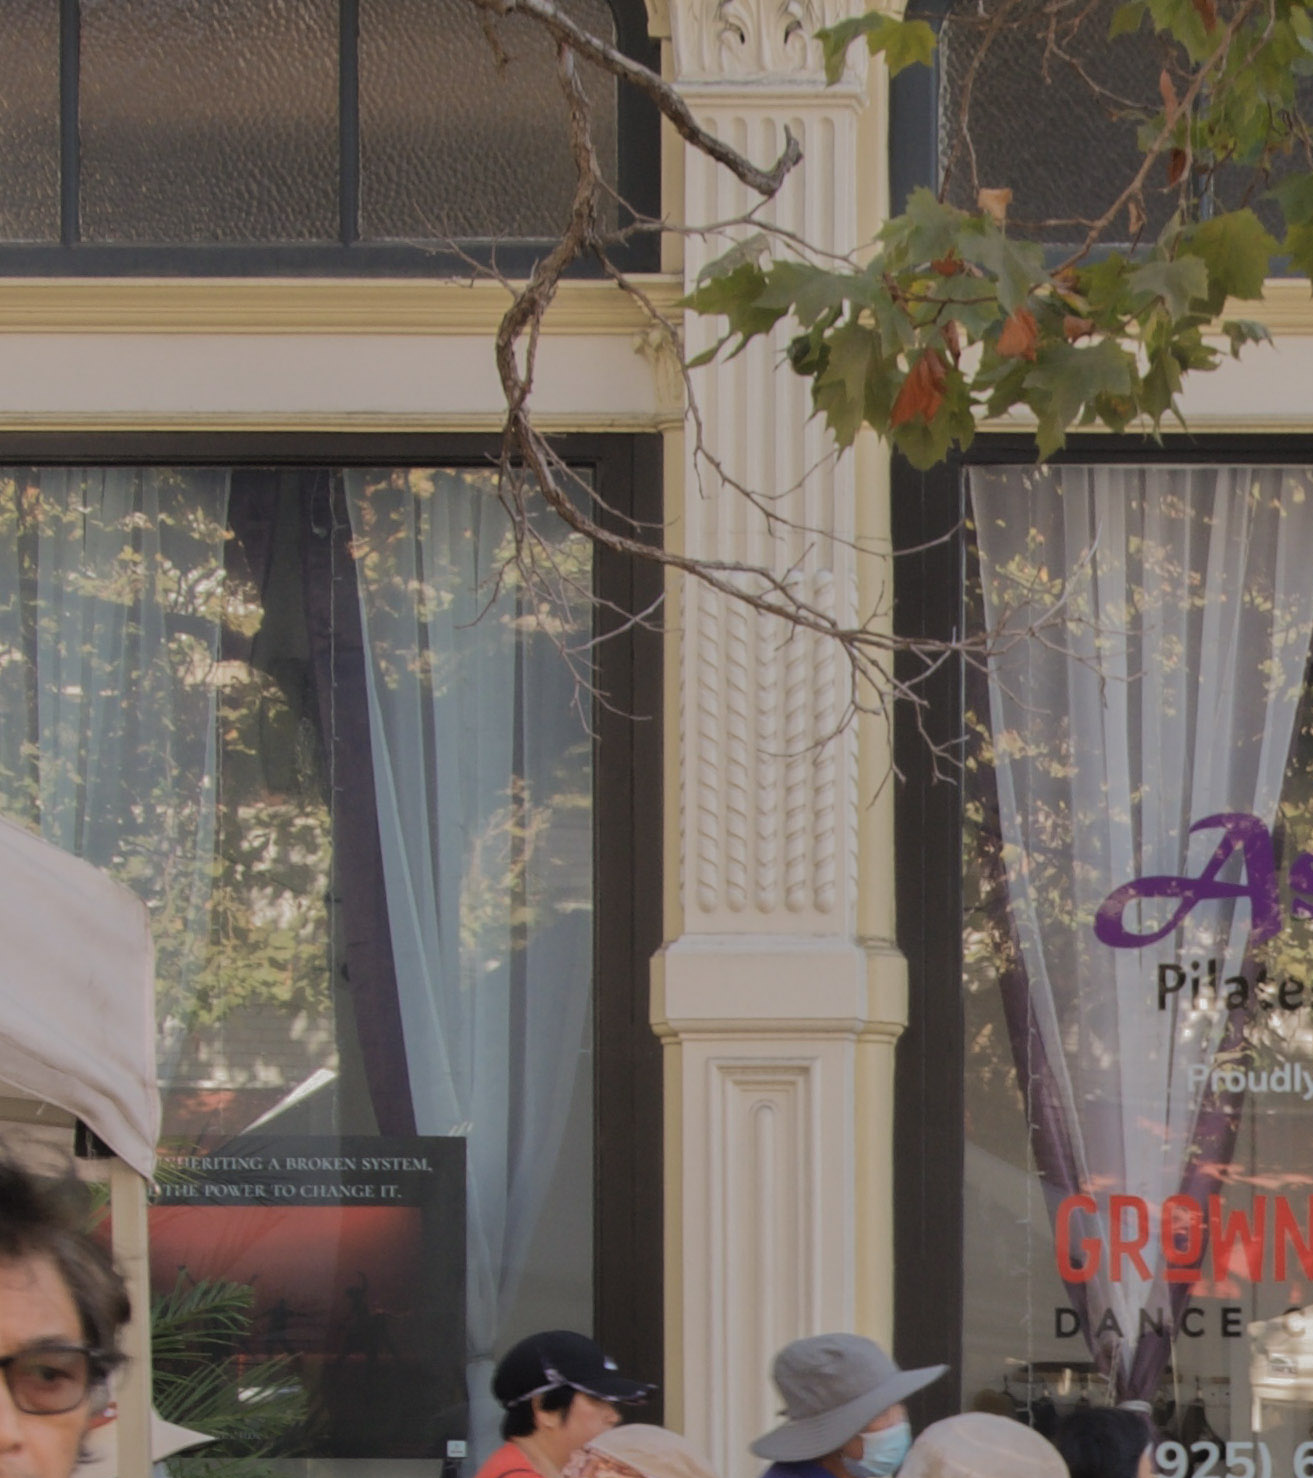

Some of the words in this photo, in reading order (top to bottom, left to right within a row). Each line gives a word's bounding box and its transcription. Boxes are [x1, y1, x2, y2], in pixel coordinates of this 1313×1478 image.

[267, 1157, 281, 1171] A
[286, 1157, 356, 1171] BROKEN
[362, 1157, 433, 1172] SYSTEM,
[165, 1184, 198, 1197] THE
[204, 1184, 266, 1198] POWER
[272, 1184, 296, 1198] TO
[301, 1184, 375, 1198] CHANGE
[380, 1184, 402, 1198] IT.
[1055, 1307, 1244, 1338] DANCE
